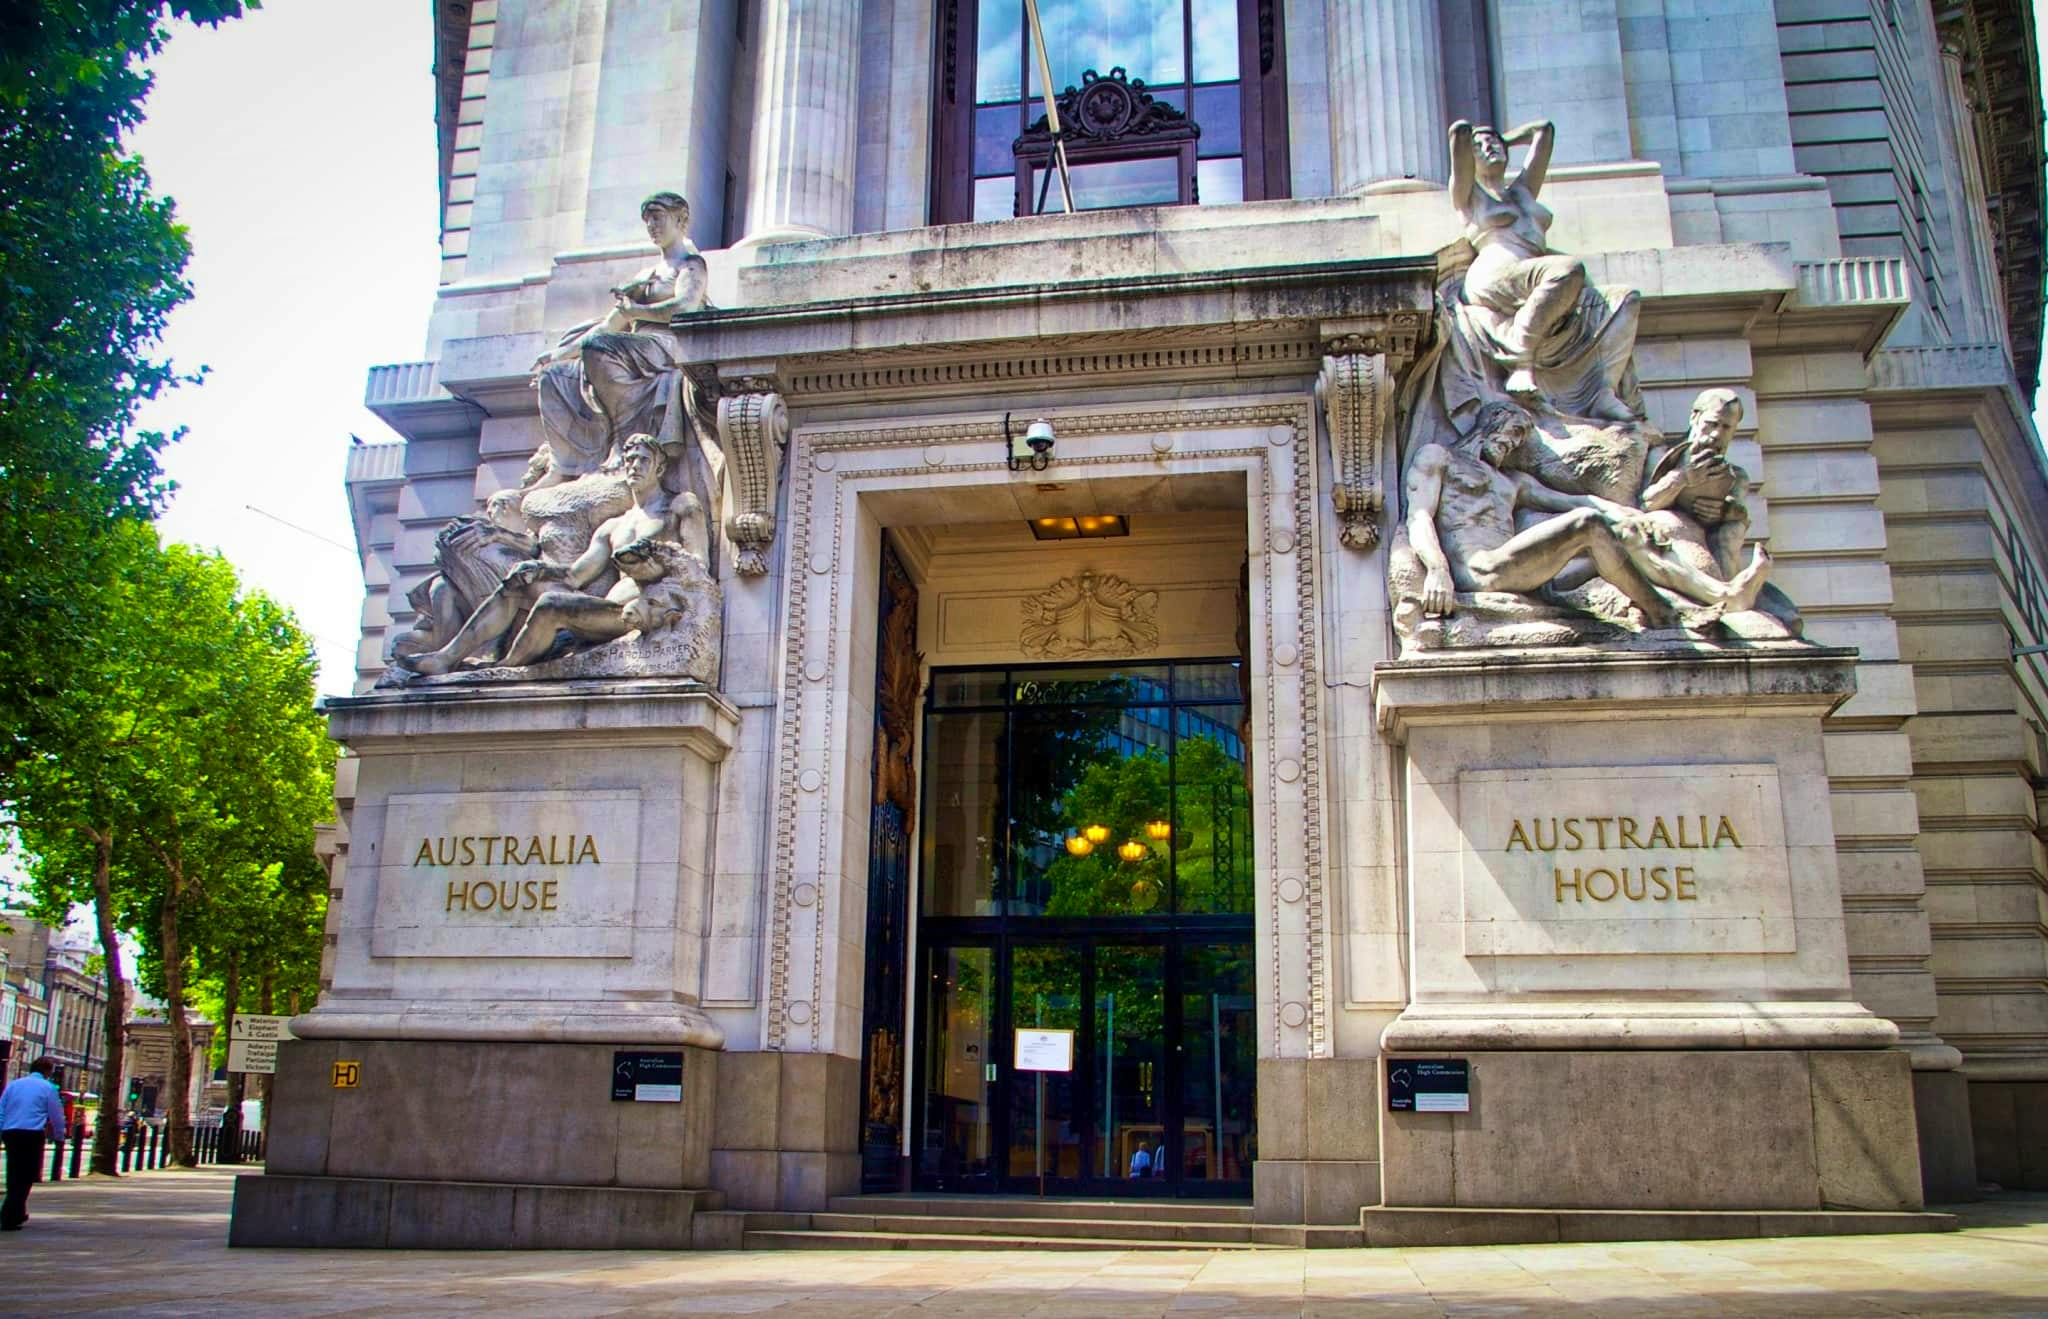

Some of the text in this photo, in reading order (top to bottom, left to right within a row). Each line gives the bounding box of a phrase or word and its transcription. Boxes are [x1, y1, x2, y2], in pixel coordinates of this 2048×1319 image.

[653, 644, 689, 657] PARKER
[1506, 815, 1743, 852] AUSTRALIA
[413, 834, 601, 867] AUSTRALIA
[446, 880, 558, 912] HOUSE
[1554, 866, 1697, 903] HOUSE
